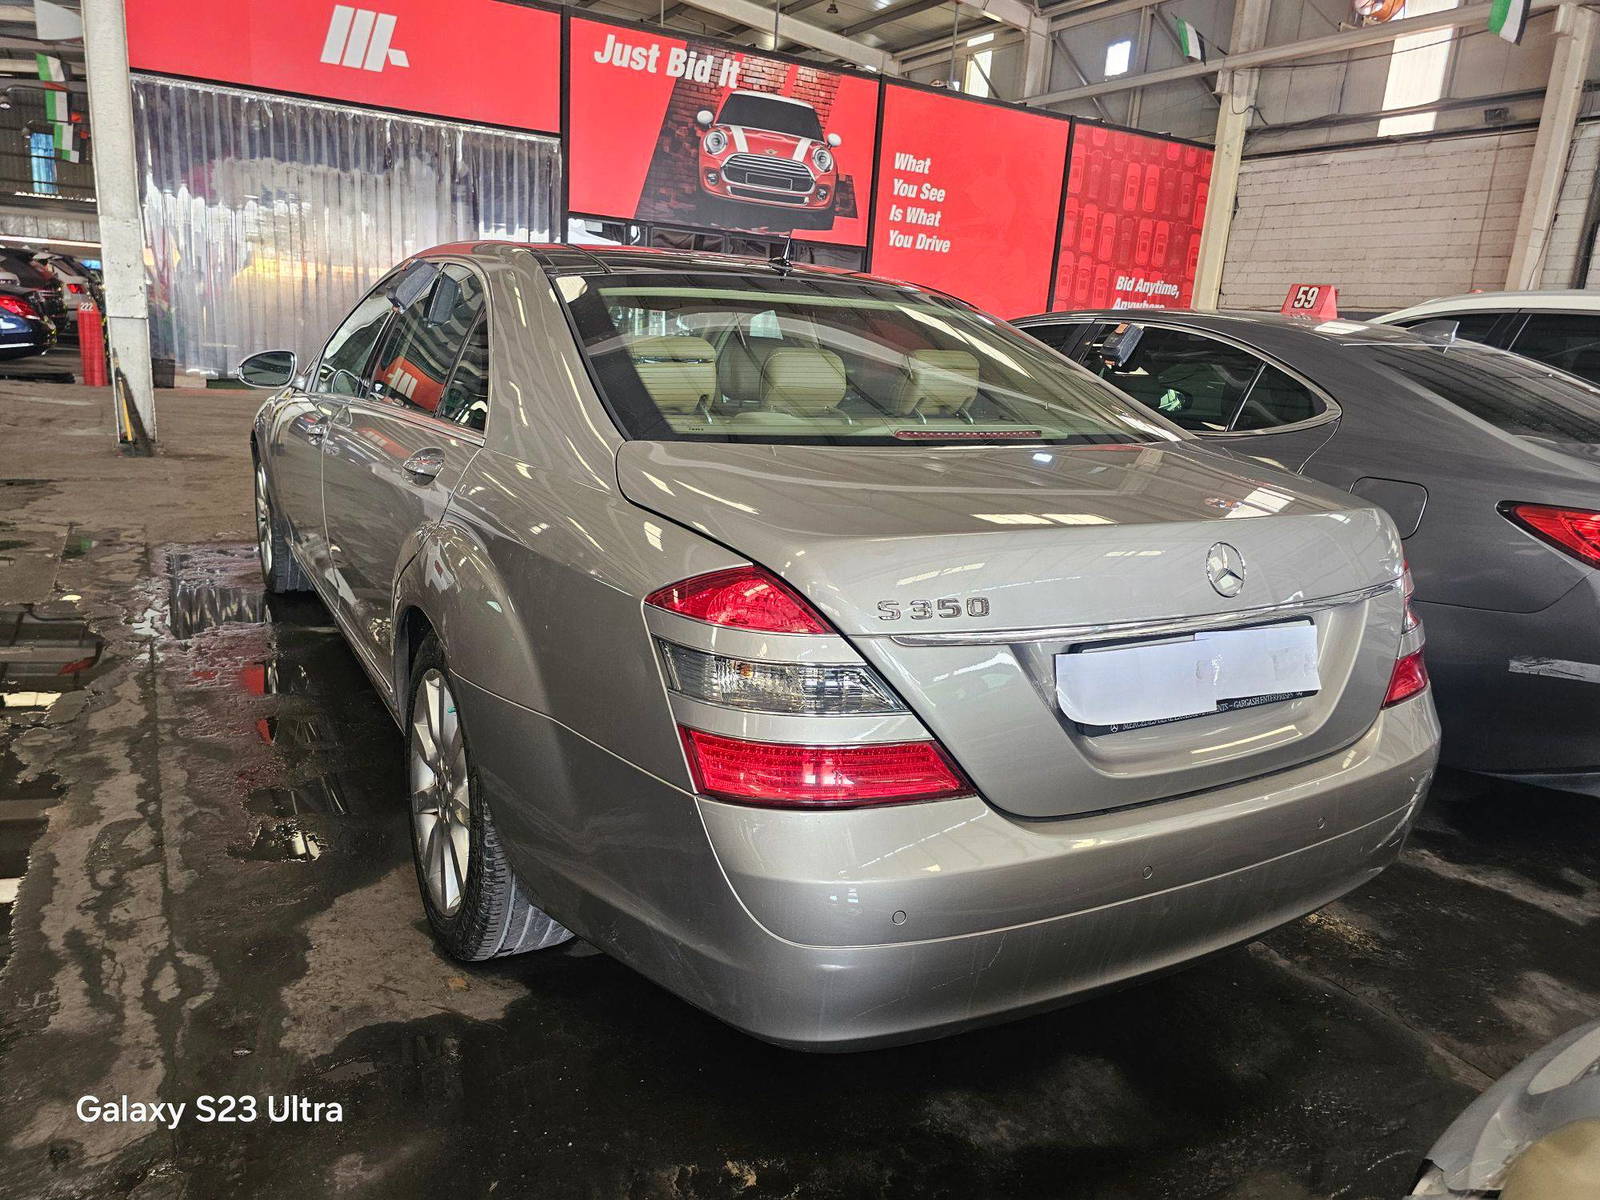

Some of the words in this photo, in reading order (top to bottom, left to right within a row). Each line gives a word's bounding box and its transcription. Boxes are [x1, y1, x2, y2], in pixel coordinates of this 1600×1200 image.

[594, 34, 660, 73] Just
[665, 46, 715, 84] Bid
[718, 57, 741, 90] It
[894, 152, 931, 174] What
[893, 178, 918, 199] You
[920, 182, 946, 203] See
[889, 204, 903, 222] Is
[906, 206, 941, 227] What
[888, 229, 914, 249] You
[915, 232, 951, 254] Drive
[1116, 276, 1136, 291] Bid
[1135, 278, 1180, 299] Anytime,
[1293, 286, 1320, 309] 59
